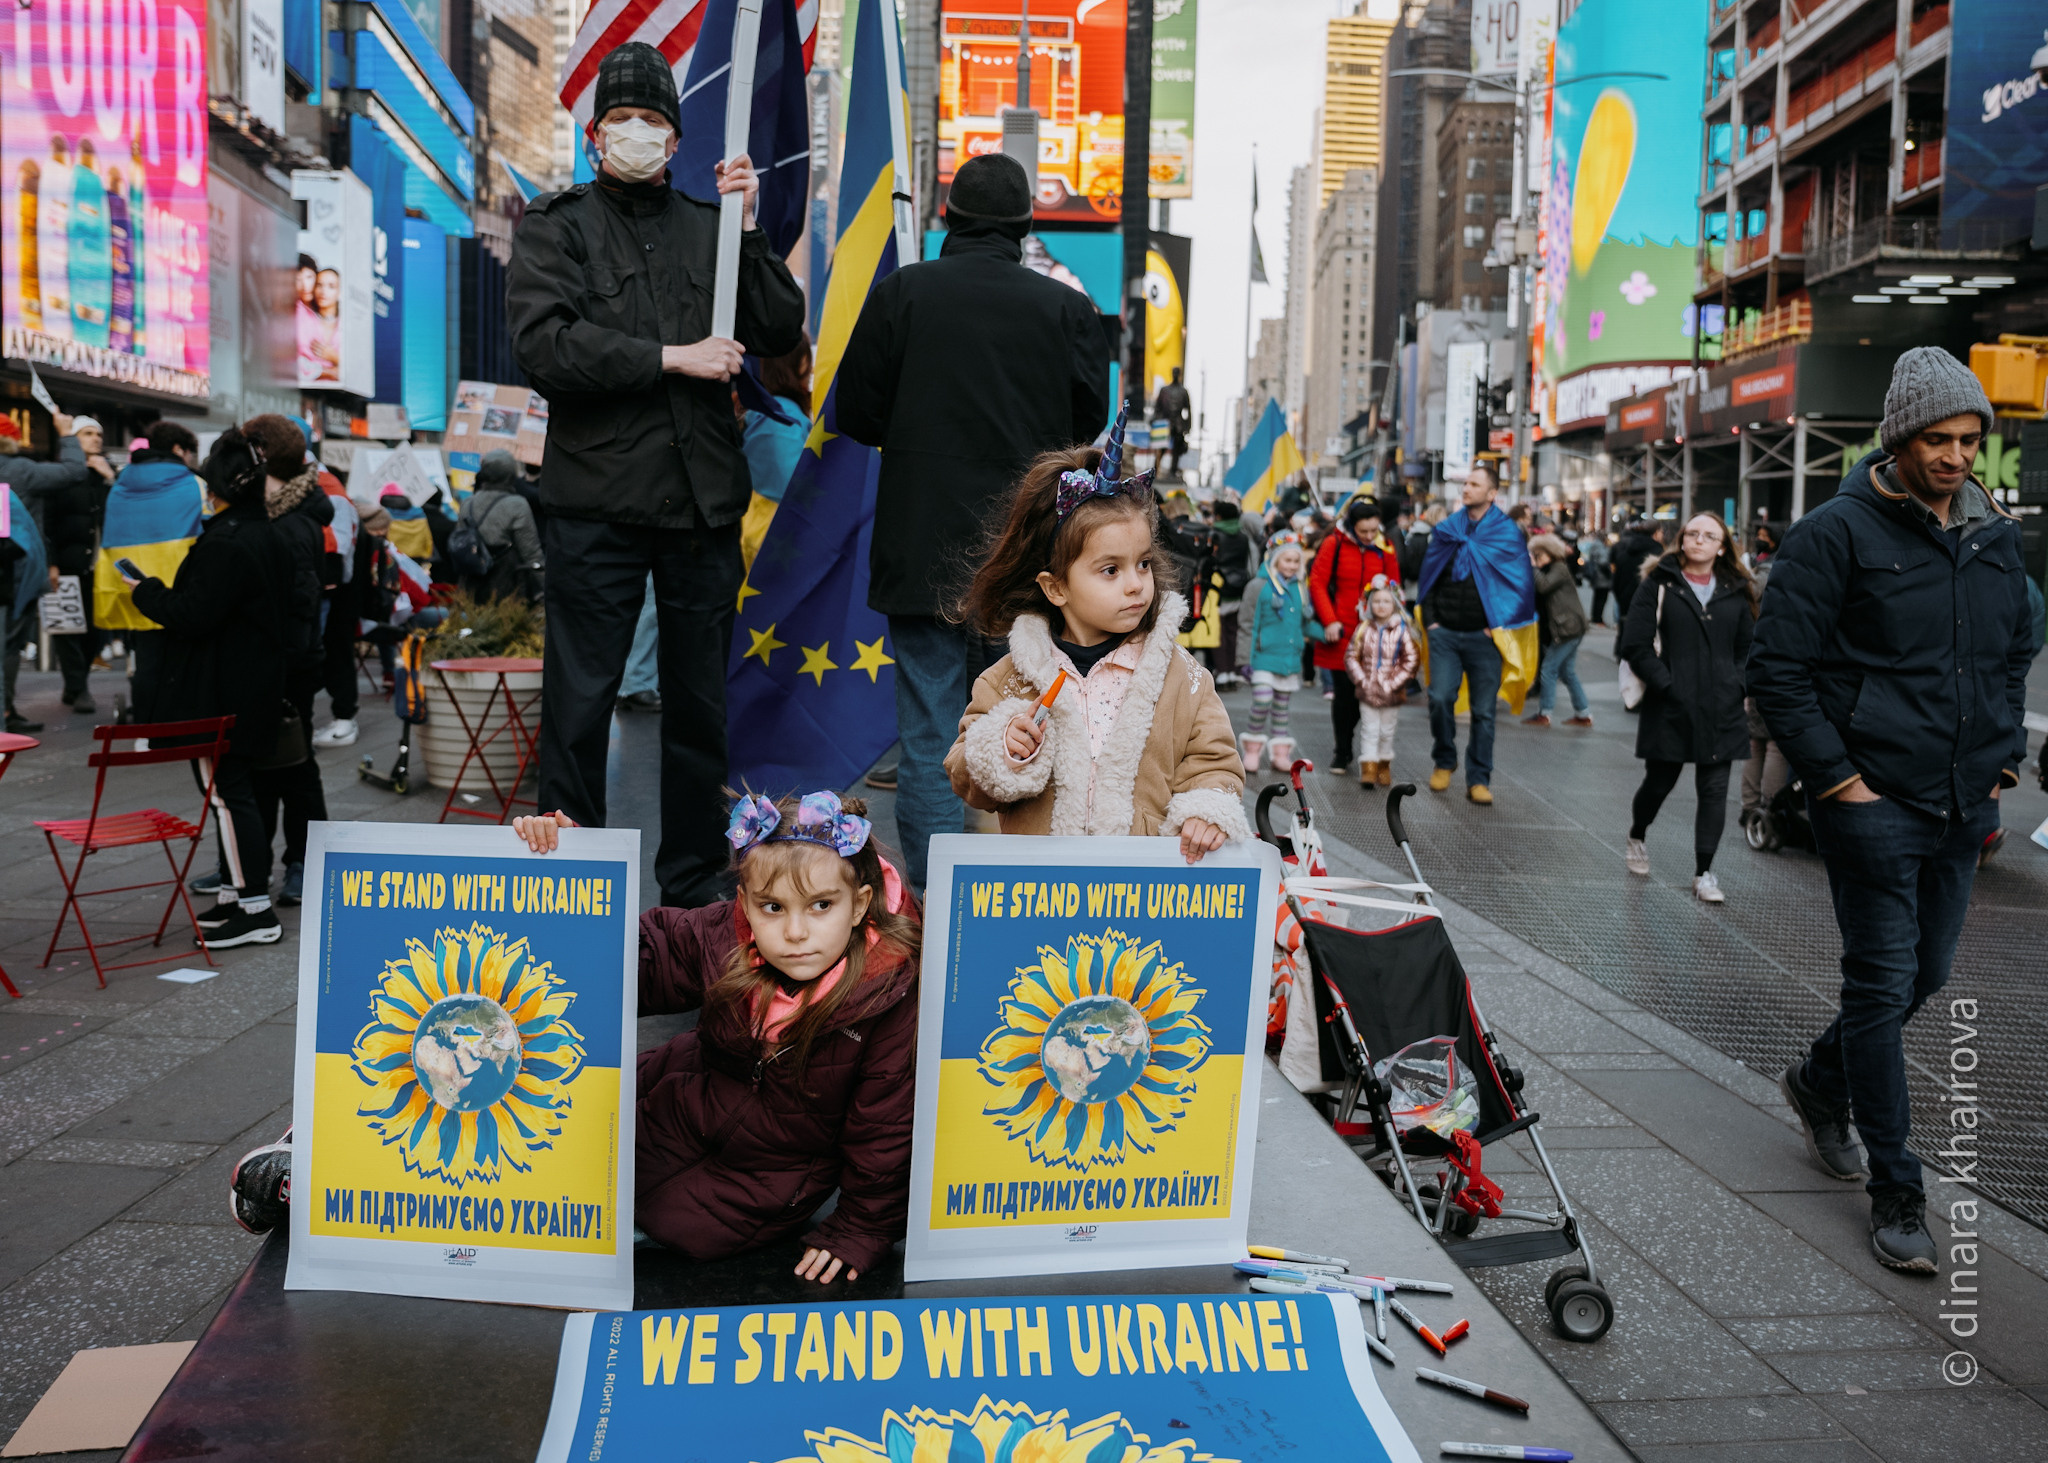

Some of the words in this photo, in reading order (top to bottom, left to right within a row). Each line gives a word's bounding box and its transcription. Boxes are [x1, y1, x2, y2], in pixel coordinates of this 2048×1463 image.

[58, 581, 85, 628] STOP
[343, 871, 373, 906] WE
[379, 871, 445, 909] STAND
[453, 874, 505, 911] WITH
[513, 876, 611, 915] UKRAINE!
[972, 883, 1004, 917] WE
[1011, 882, 1079, 917] STAND
[1088, 884, 1140, 917] WITH
[1148, 884, 1244, 918] UKRAINE!
[326, 1189, 353, 1222] МИ
[361, 1188, 503, 1233] ПІДТРИМУЄМО
[511, 1197, 601, 1239] УКРАЇНУ!
[947, 1184, 976, 1215] МИ
[983, 1178, 1126, 1219] ПІДТРИМУЄМО
[1132, 1171, 1219, 1208] УКРАЇНУ!
[610, 1316, 623, 1345] ©2022
[642, 1316, 718, 1385] WE
[735, 1311, 903, 1383] STAND
[920, 1307, 1051, 1378] WITH
[1067, 1301, 1307, 1376] UKRAINE!
[606, 1347, 618, 1370] ALL
[600, 1373, 616, 1414] RIGHTS
[589, 1416, 609, 1462] RESERVED
